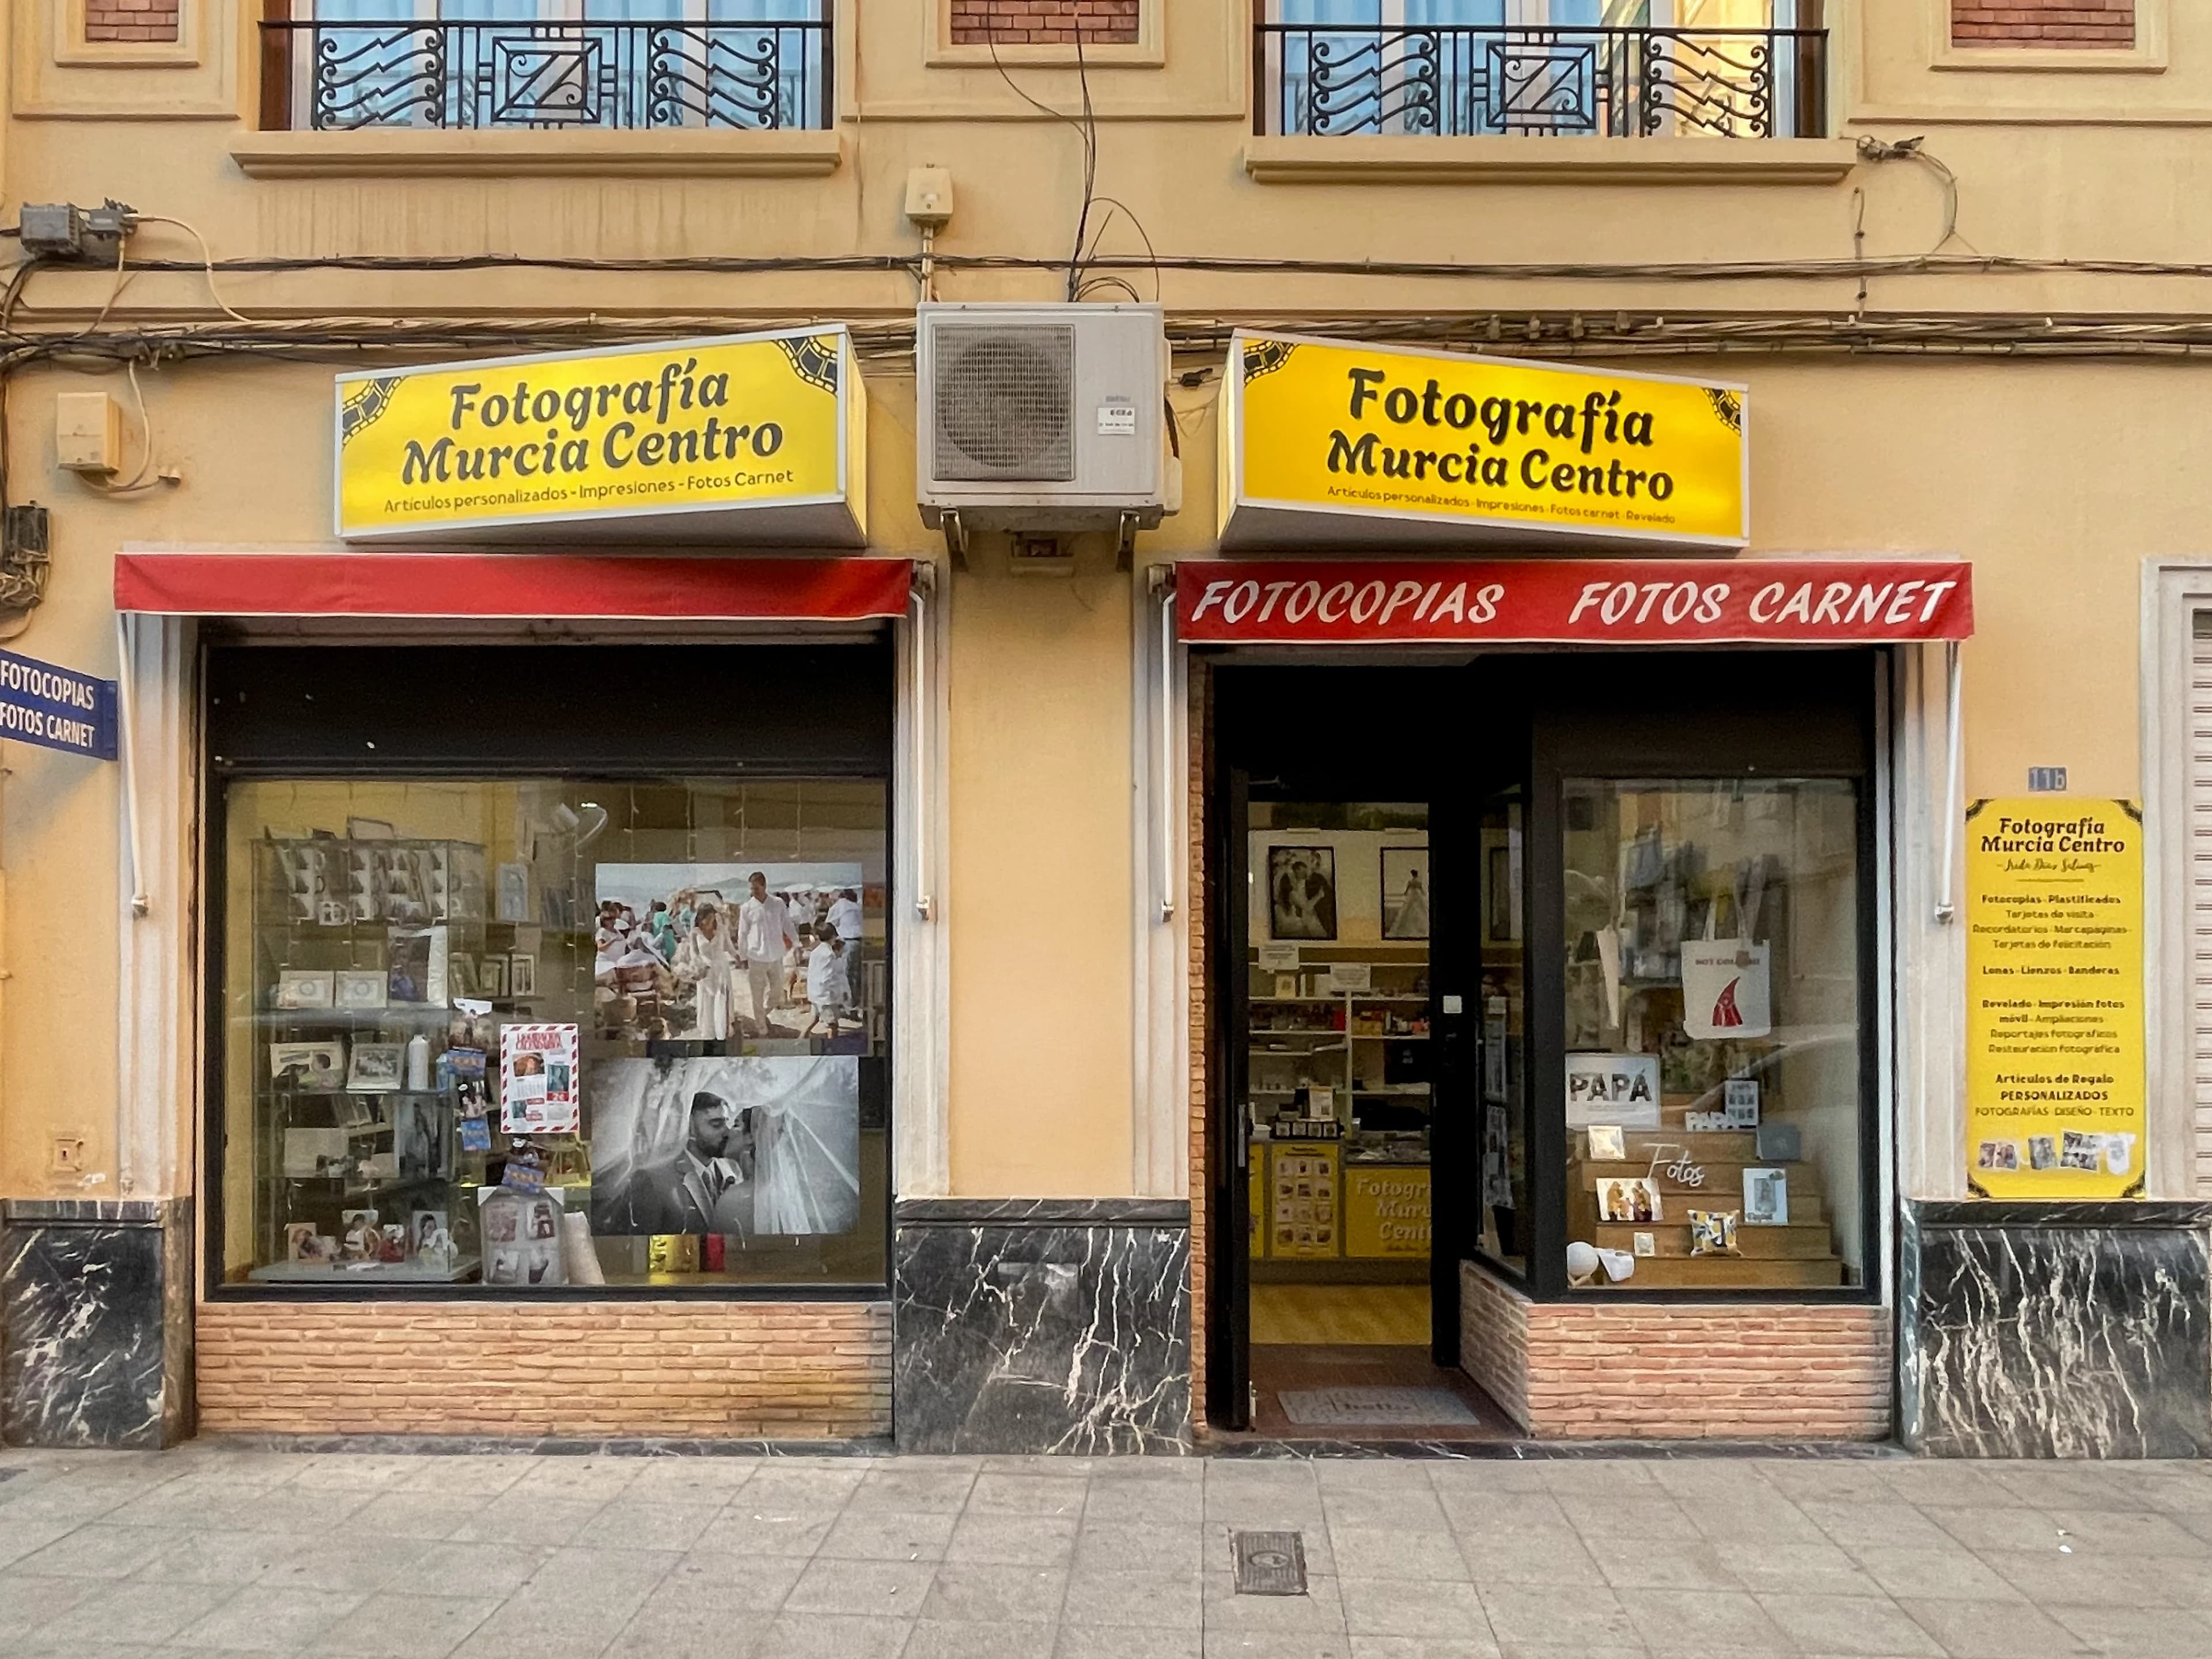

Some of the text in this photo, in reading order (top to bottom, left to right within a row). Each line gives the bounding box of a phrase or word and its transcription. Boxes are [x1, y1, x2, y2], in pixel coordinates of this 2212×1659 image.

[450, 358, 729, 431] Fotografía
[1348, 367, 1654, 453] Fotografía
[402, 418, 782, 485] Murcia Centro
[1327, 430, 1674, 501] Murcia Centro
[454, 487, 567, 511] personalizados
[579, 480, 675, 499] Impresiones
[688, 475, 730, 490] Fotos
[735, 470, 794, 486] Carnet
[1384, 491, 1469, 507] personalizados
[1476, 498, 1544, 513] Impresiones
[1550, 504, 1581, 516] Fotos
[1584, 509, 1620, 520] carnet
[1626, 510, 1676, 524] Revelado
[1191, 579, 1957, 625] FOTOCOPIAS FOTOS CARNET
[0, 659, 94, 710] FOTOCOPIAS
[0, 701, 96, 748] FOTOS CARNET
[2030, 768, 2067, 791] 11b
[1981, 835, 2125, 853] Murcia Centro
[1999, 816, 2104, 838] Fotografía
[1570, 1069, 1653, 1101] PAPÁ
[2001, 1090, 2108, 1101] PERSONALIZADOS
[2055, 1074, 2070, 1084] de
[2072, 1073, 2115, 1085] Regalo
[2100, 1106, 2134, 1116] TEXTO
[1642, 1143, 1705, 1187] Fotos
[1356, 1177, 1431, 1201] Fotogr
